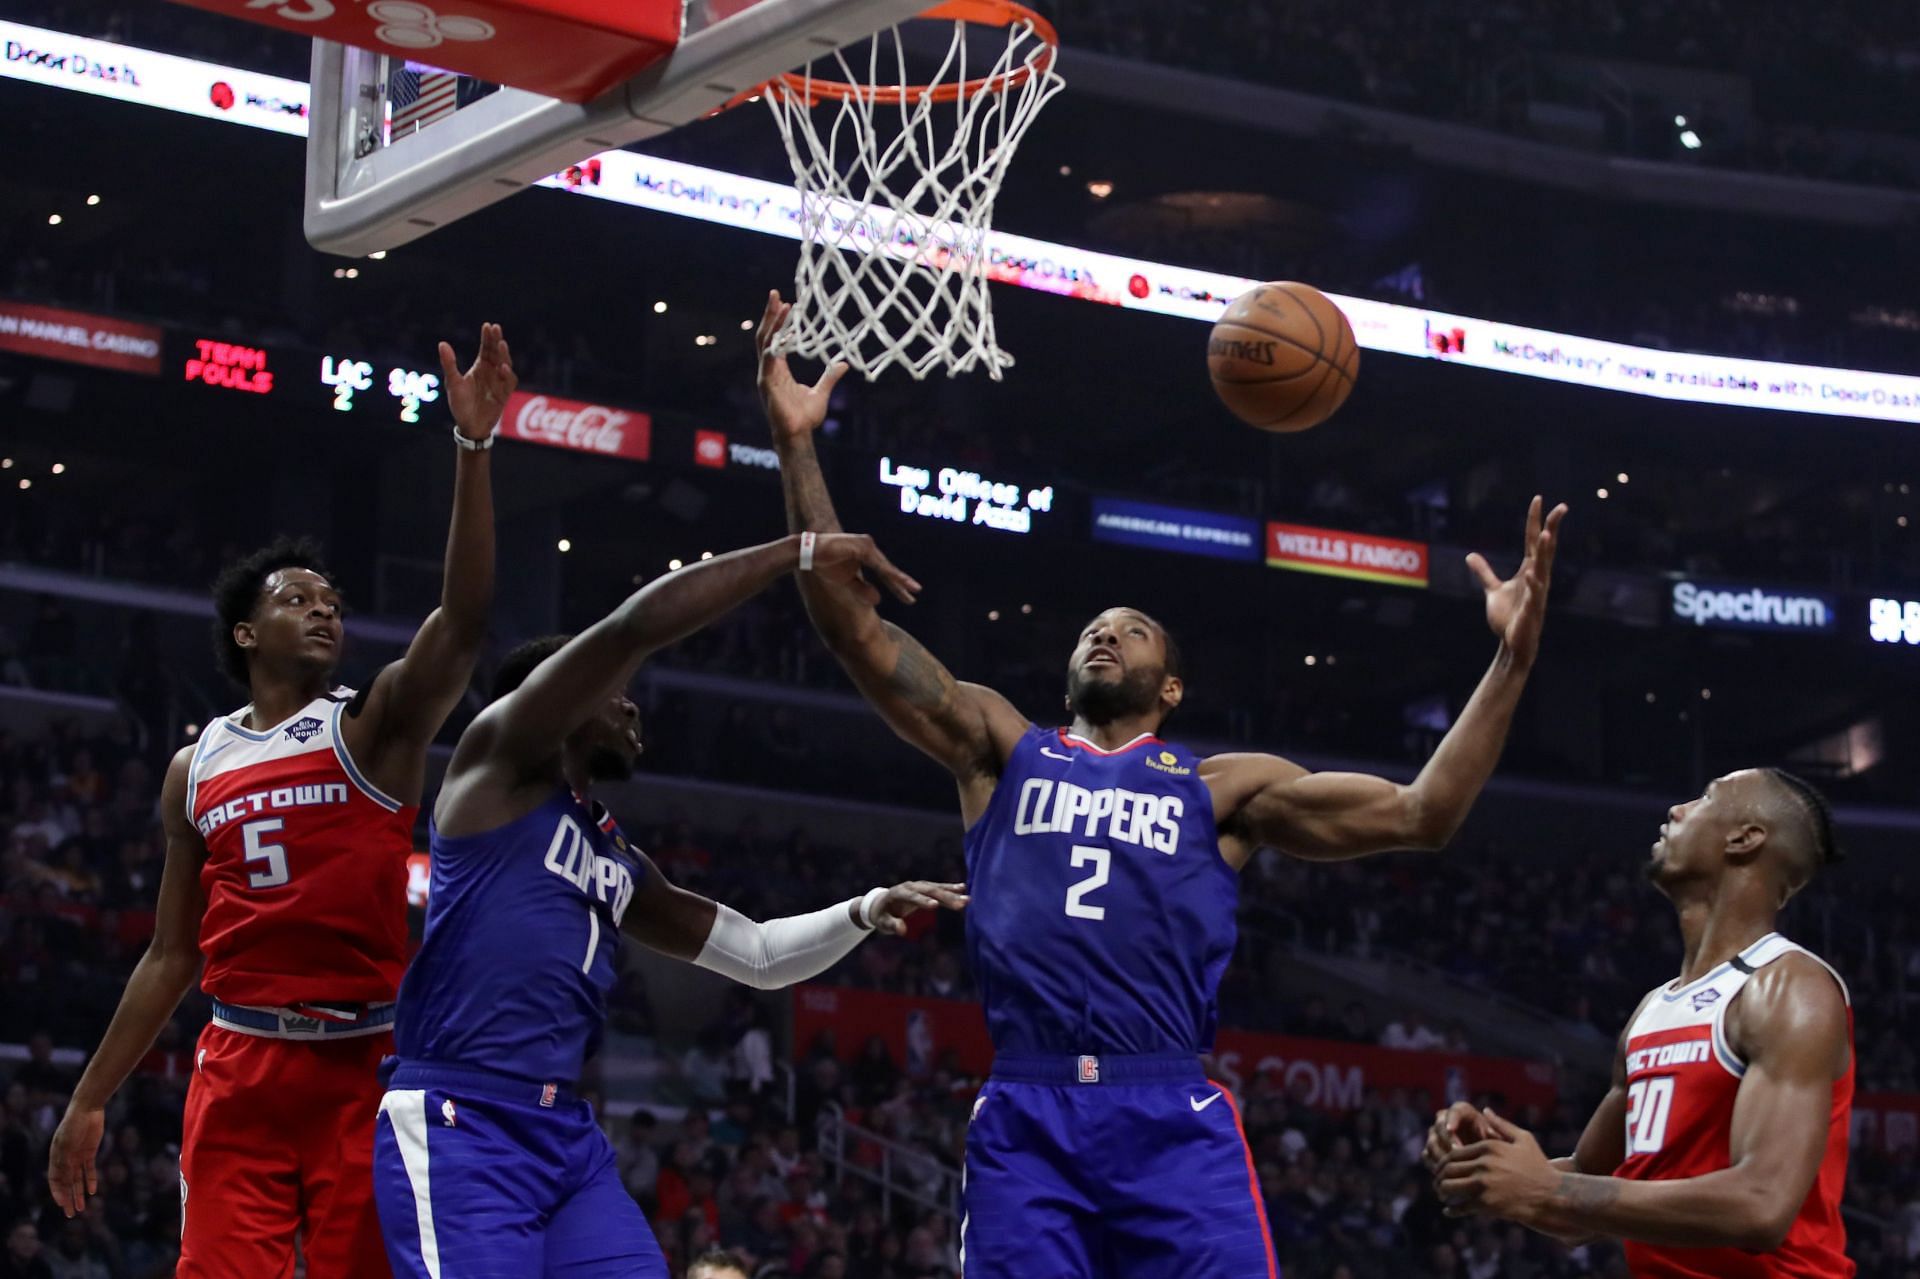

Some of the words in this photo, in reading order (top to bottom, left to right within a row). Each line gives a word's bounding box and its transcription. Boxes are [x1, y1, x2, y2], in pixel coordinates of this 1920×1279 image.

[0, 315, 18, 334] AN
[19, 317, 90, 348] MANUEL
[93, 330, 159, 358] CASINO
[196, 339, 266, 370] TEAM
[185, 359, 273, 393] FOULS
[321, 356, 372, 390] LAC
[389, 368, 439, 402] SAC
[1665, 370, 1759, 392] available
[334, 386, 353, 411] 2
[400, 396, 420, 423] 2
[729, 443, 781, 470] TOYO
[880, 457, 929, 489] Law
[939, 468, 1019, 506] Offices
[1028, 487, 1053, 512] of
[901, 486, 966, 521] David
[1097, 514, 1180, 537] AMERICAN
[1183, 525, 1251, 547] EXPRESS
[1276, 531, 1347, 562] WELLS
[1351, 543, 1420, 572] FARGO
[1673, 581, 1826, 626] Spectrum
[1145, 756, 1190, 776] bumble
[196, 783, 347, 834] SACTOWN
[1014, 778, 1184, 855] CLIPPERS
[242, 817, 290, 889] 5
[1065, 845, 1111, 920] 2
[582, 905, 600, 975] 1
[1625, 1076, 1674, 1160] 20
